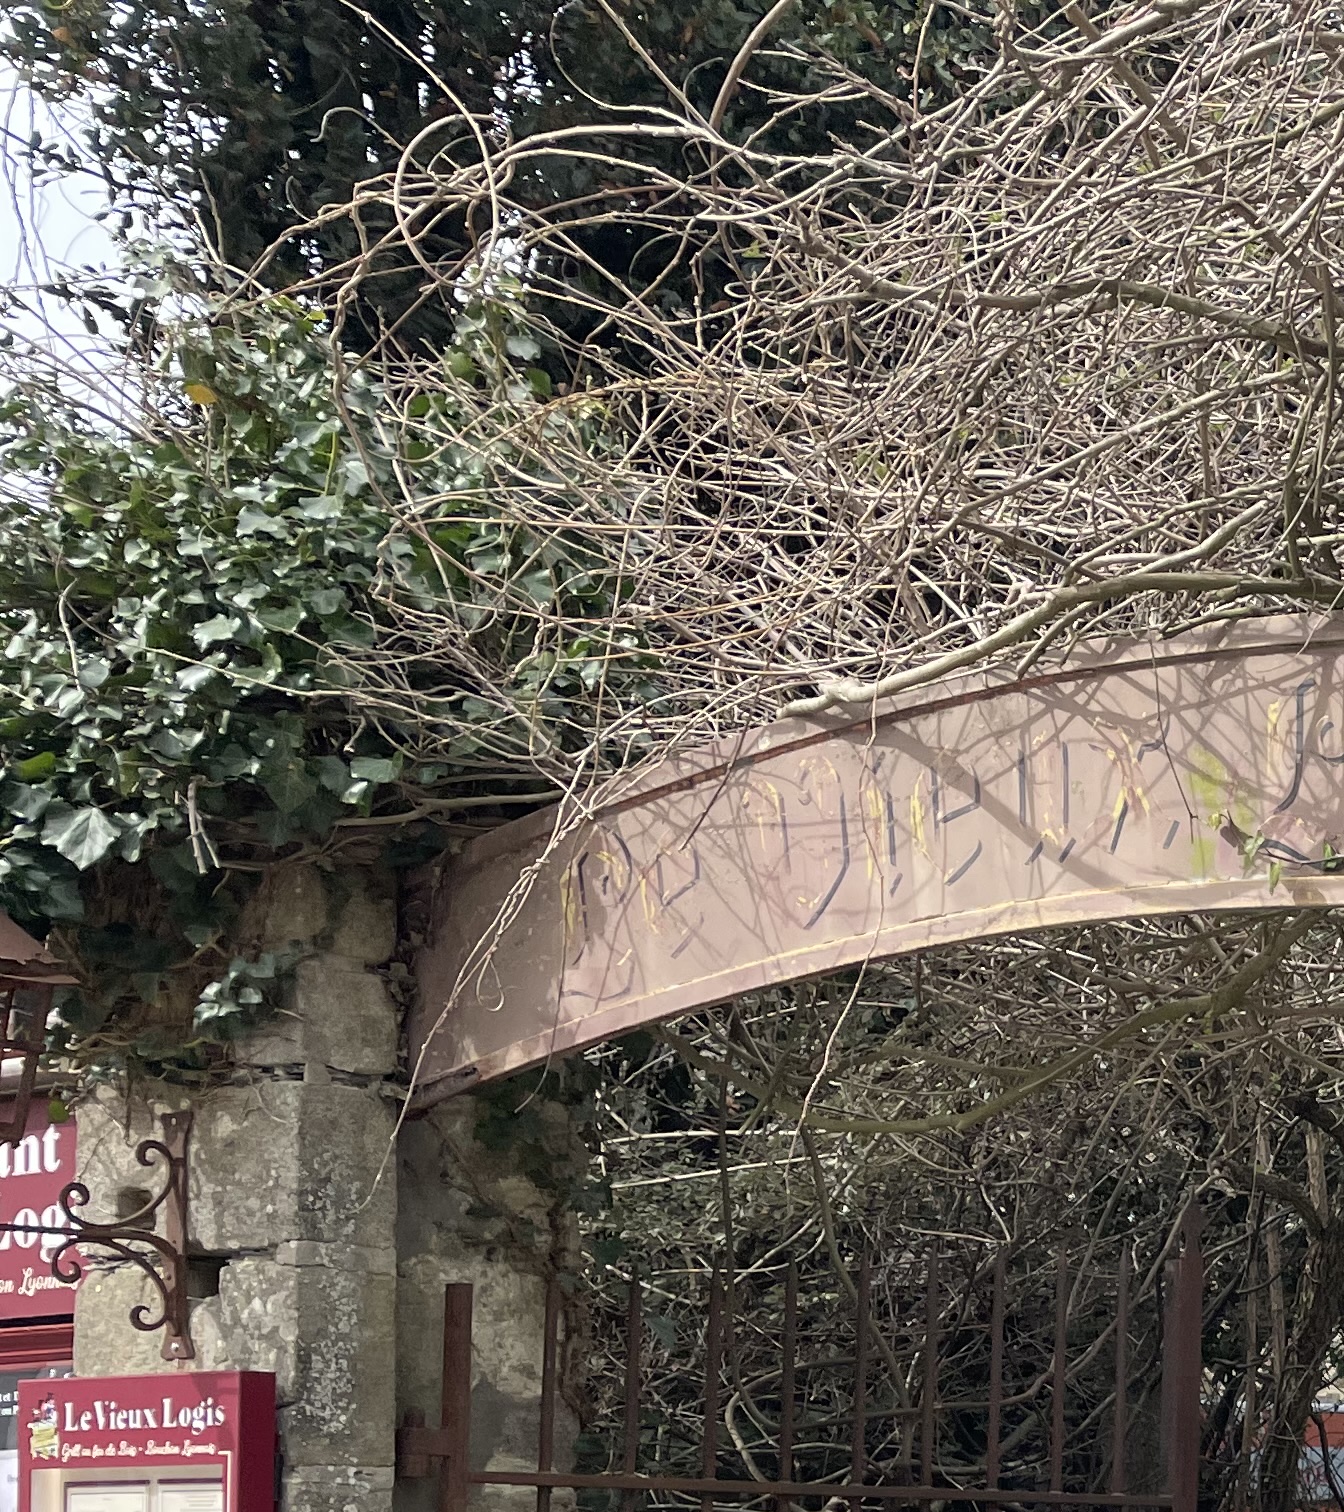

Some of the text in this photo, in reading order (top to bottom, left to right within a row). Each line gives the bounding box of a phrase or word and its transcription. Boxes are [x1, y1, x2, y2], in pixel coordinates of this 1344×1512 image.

[64, 1397, 226, 1436] Le Vieux Logis
